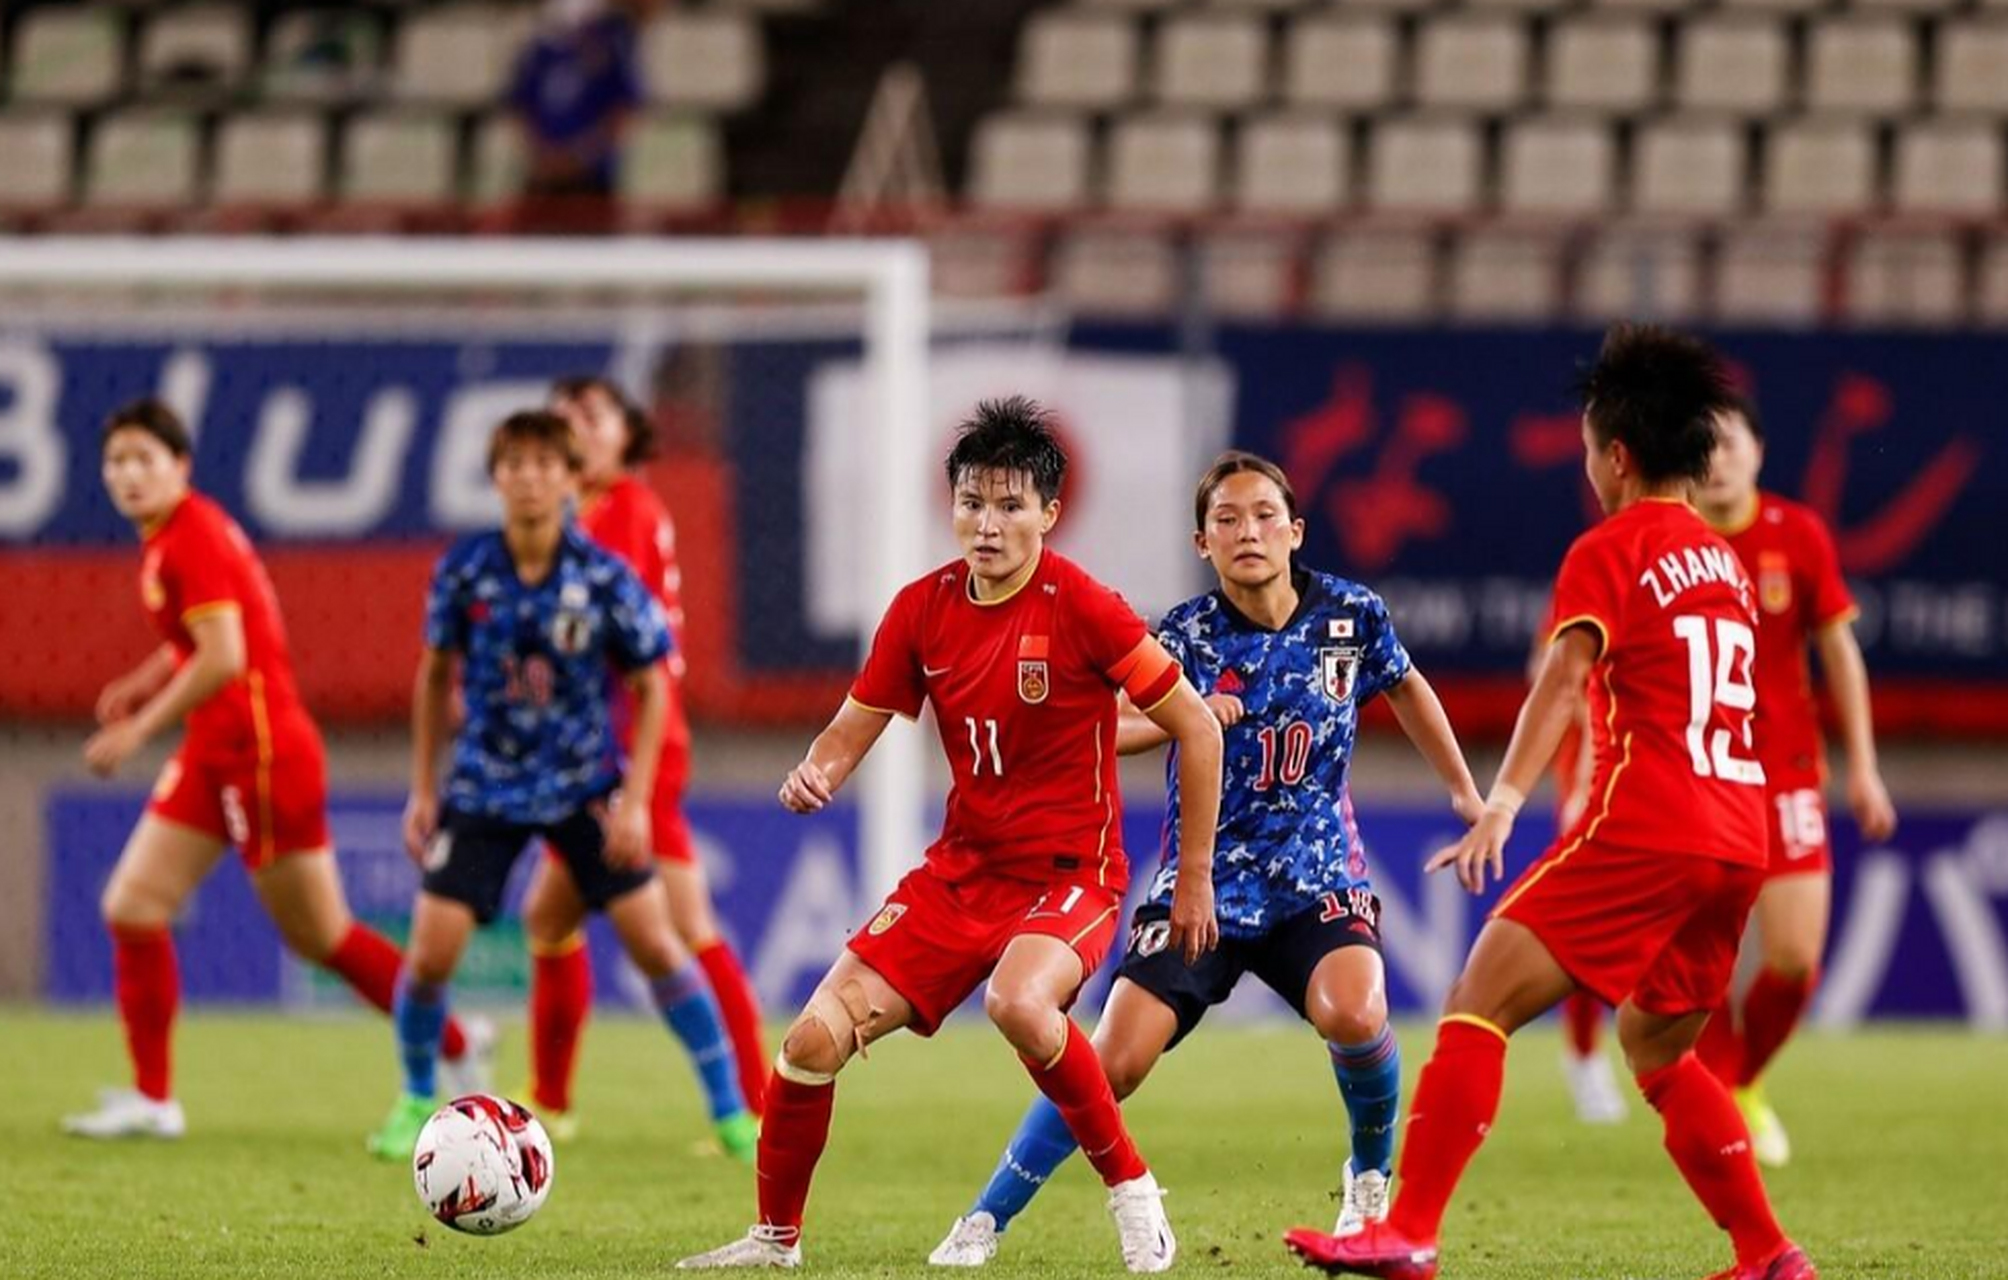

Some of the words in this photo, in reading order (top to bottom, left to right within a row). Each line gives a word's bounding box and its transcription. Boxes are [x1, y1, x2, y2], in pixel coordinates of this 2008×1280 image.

[1673, 616, 1766, 785] 19
[965, 716, 1002, 776] 11
[1253, 721, 1313, 791] 10
